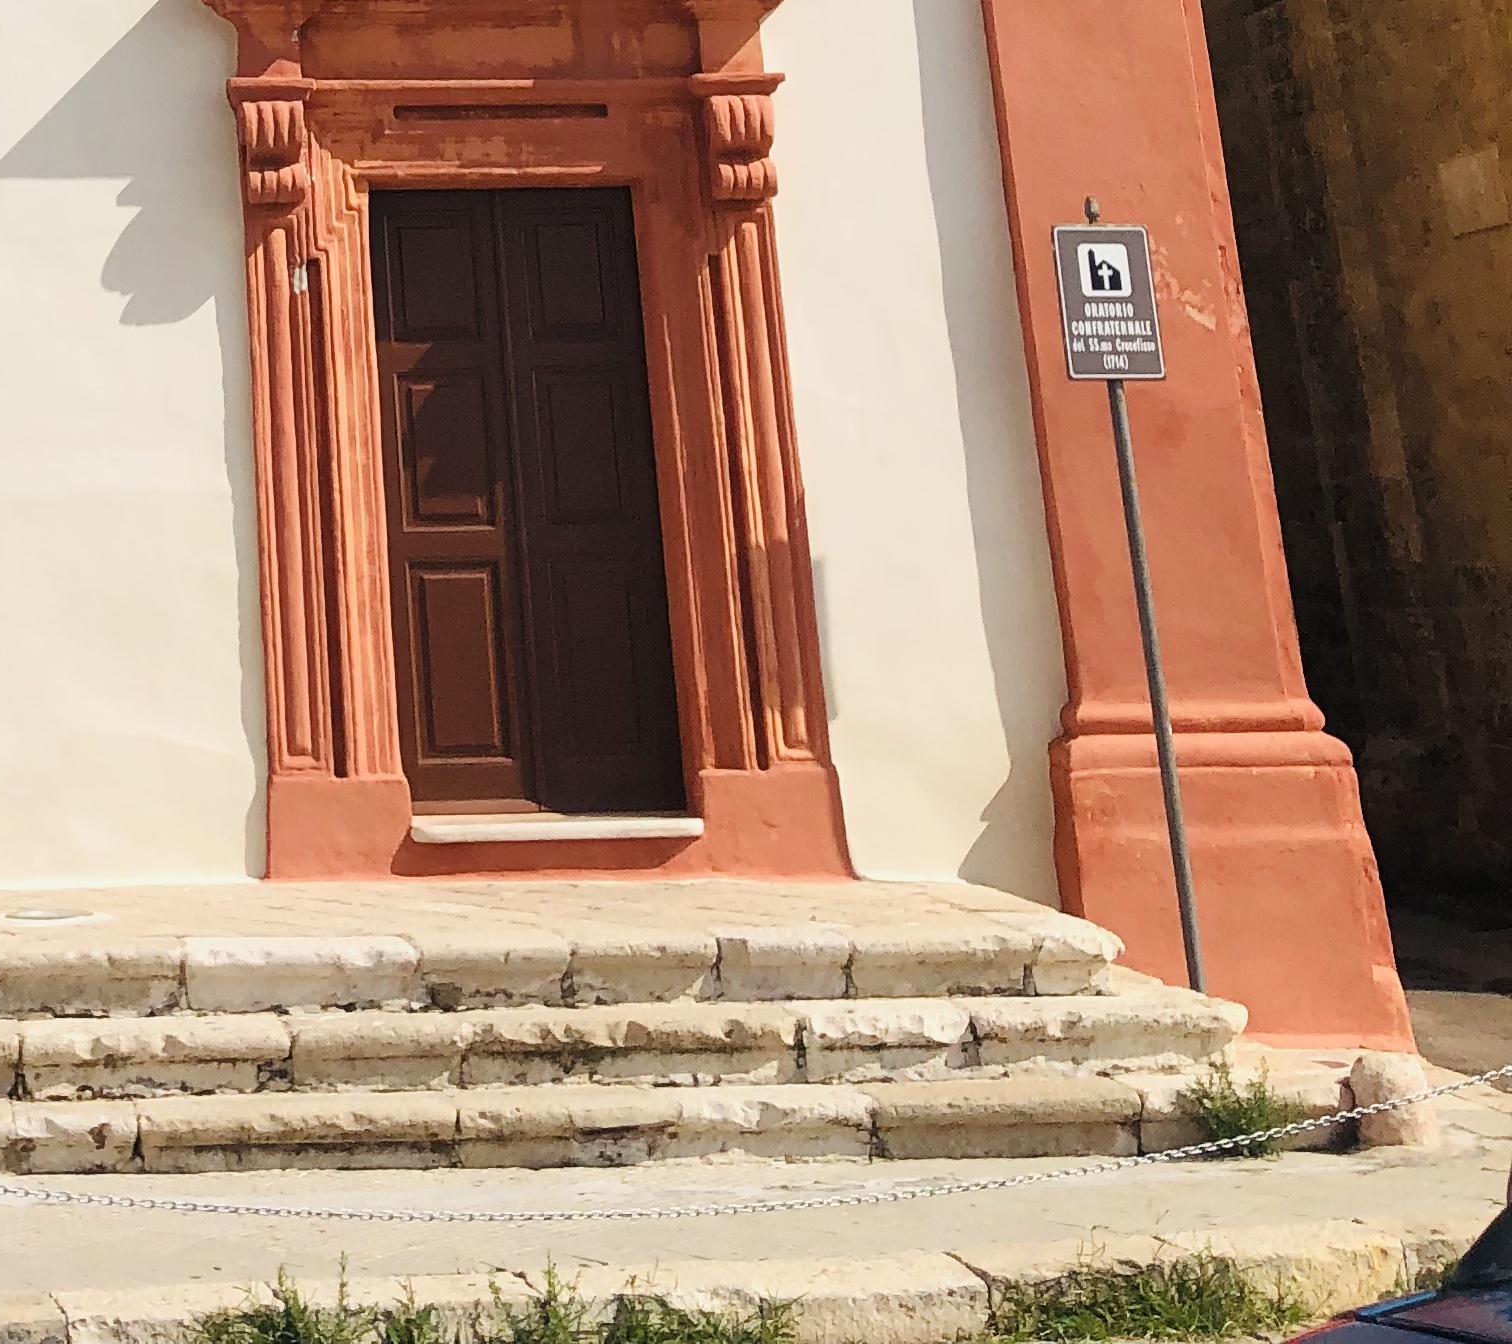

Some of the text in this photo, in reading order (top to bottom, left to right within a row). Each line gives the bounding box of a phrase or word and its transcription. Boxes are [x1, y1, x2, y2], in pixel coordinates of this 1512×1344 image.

[1085, 302, 1134, 318] ORATORIO
[1071, 320, 1153, 336] CONFRATERNALE
[1103, 354, 1129, 371] (1714)
